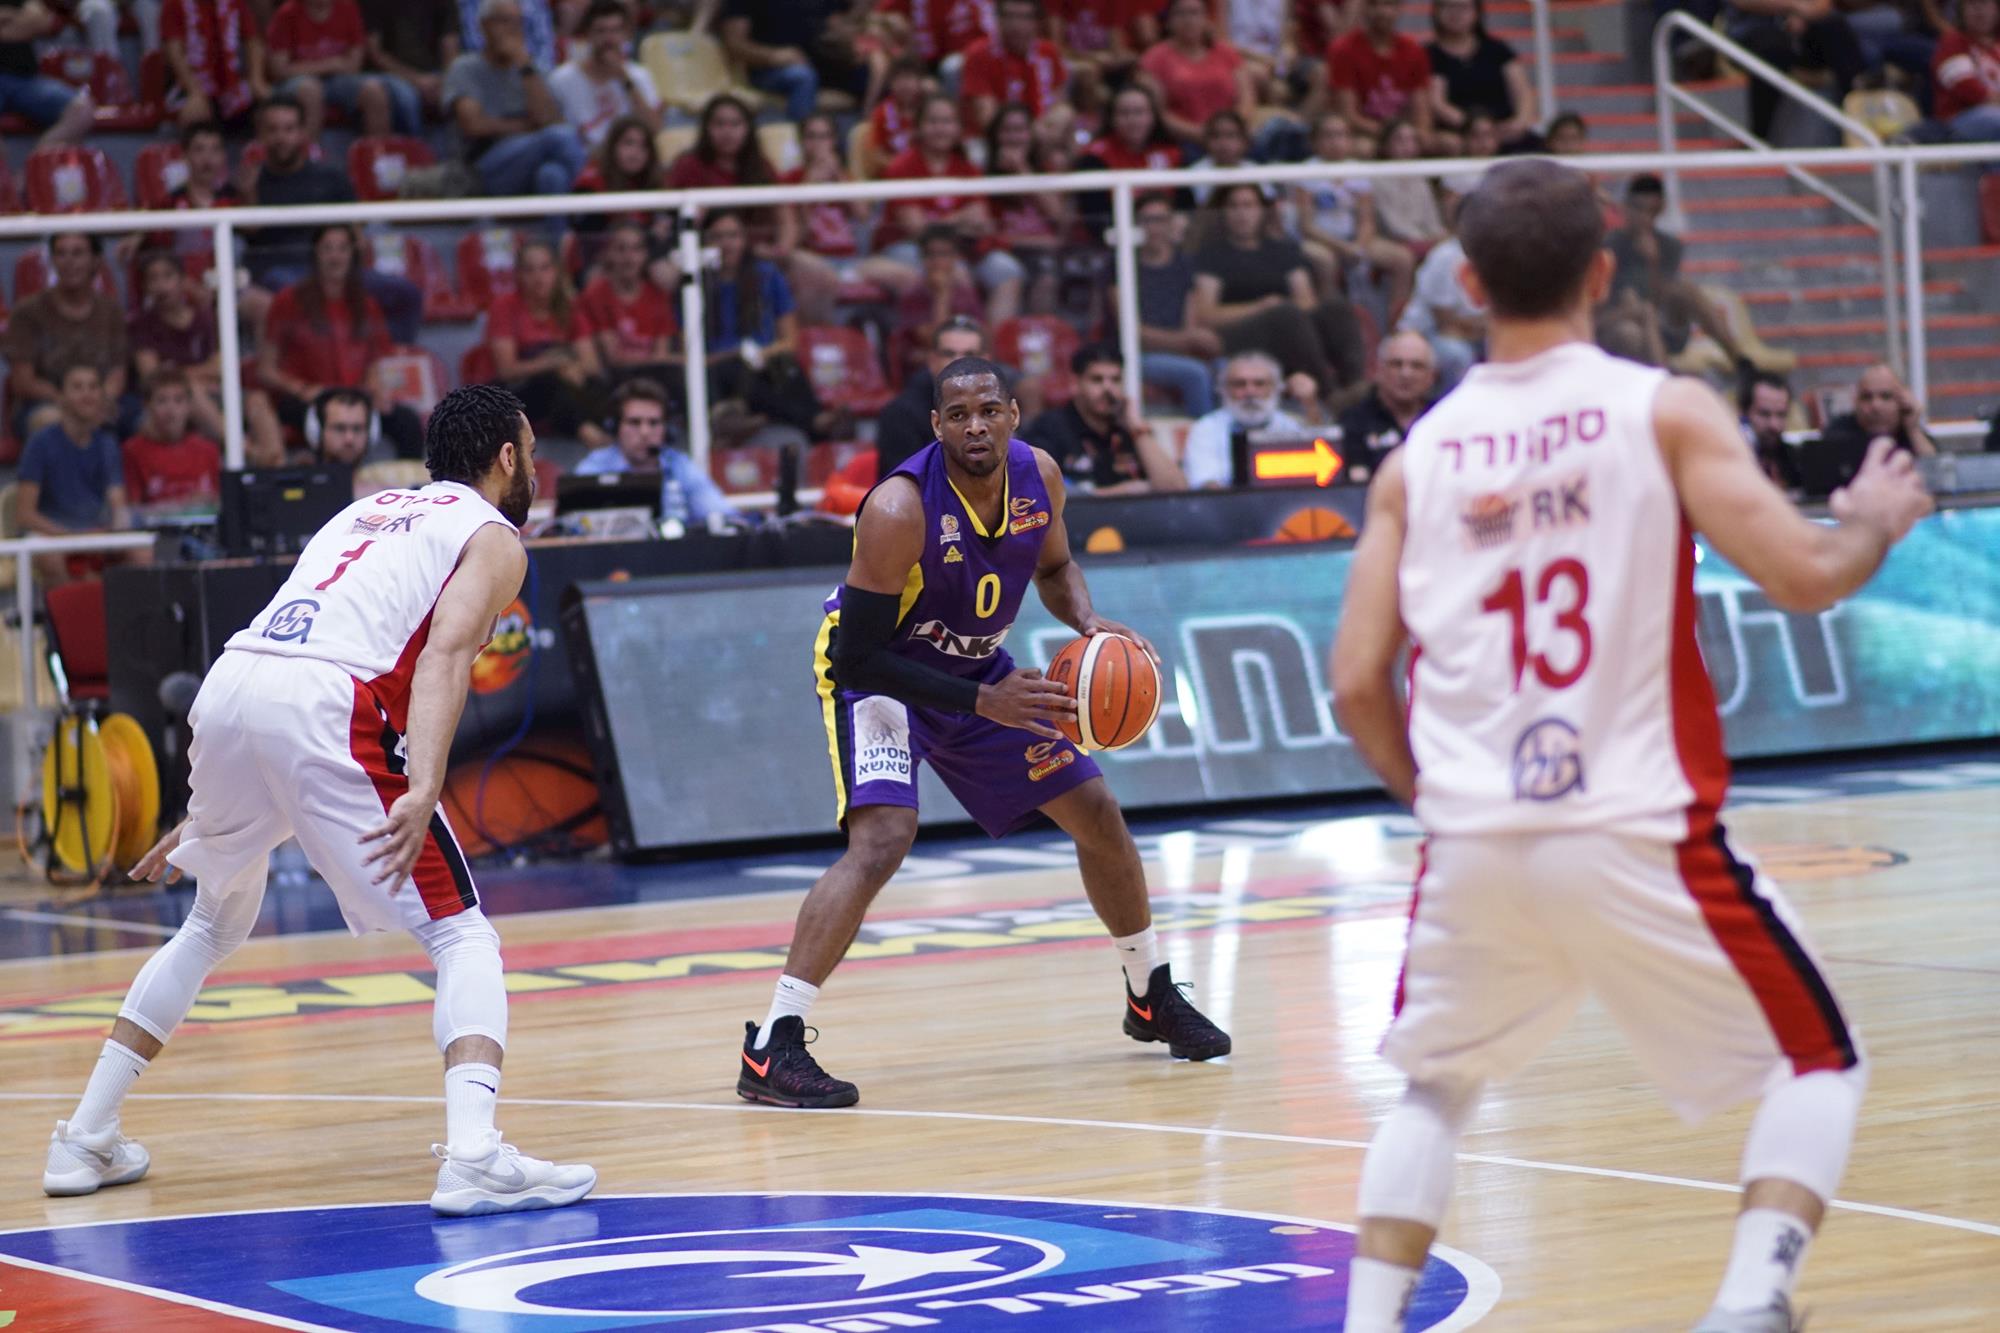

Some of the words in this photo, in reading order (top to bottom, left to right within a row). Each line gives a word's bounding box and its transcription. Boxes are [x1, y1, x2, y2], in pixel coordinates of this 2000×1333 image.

[381, 513, 425, 533] RK
[1532, 474, 1591, 529] RK
[975, 573, 1001, 619] 0
[1482, 558, 1592, 691] 13
[858, 759, 910, 776] שאשא
[864, 746, 910, 761] מסיעי
[915, 1262, 1335, 1315] מפעל
